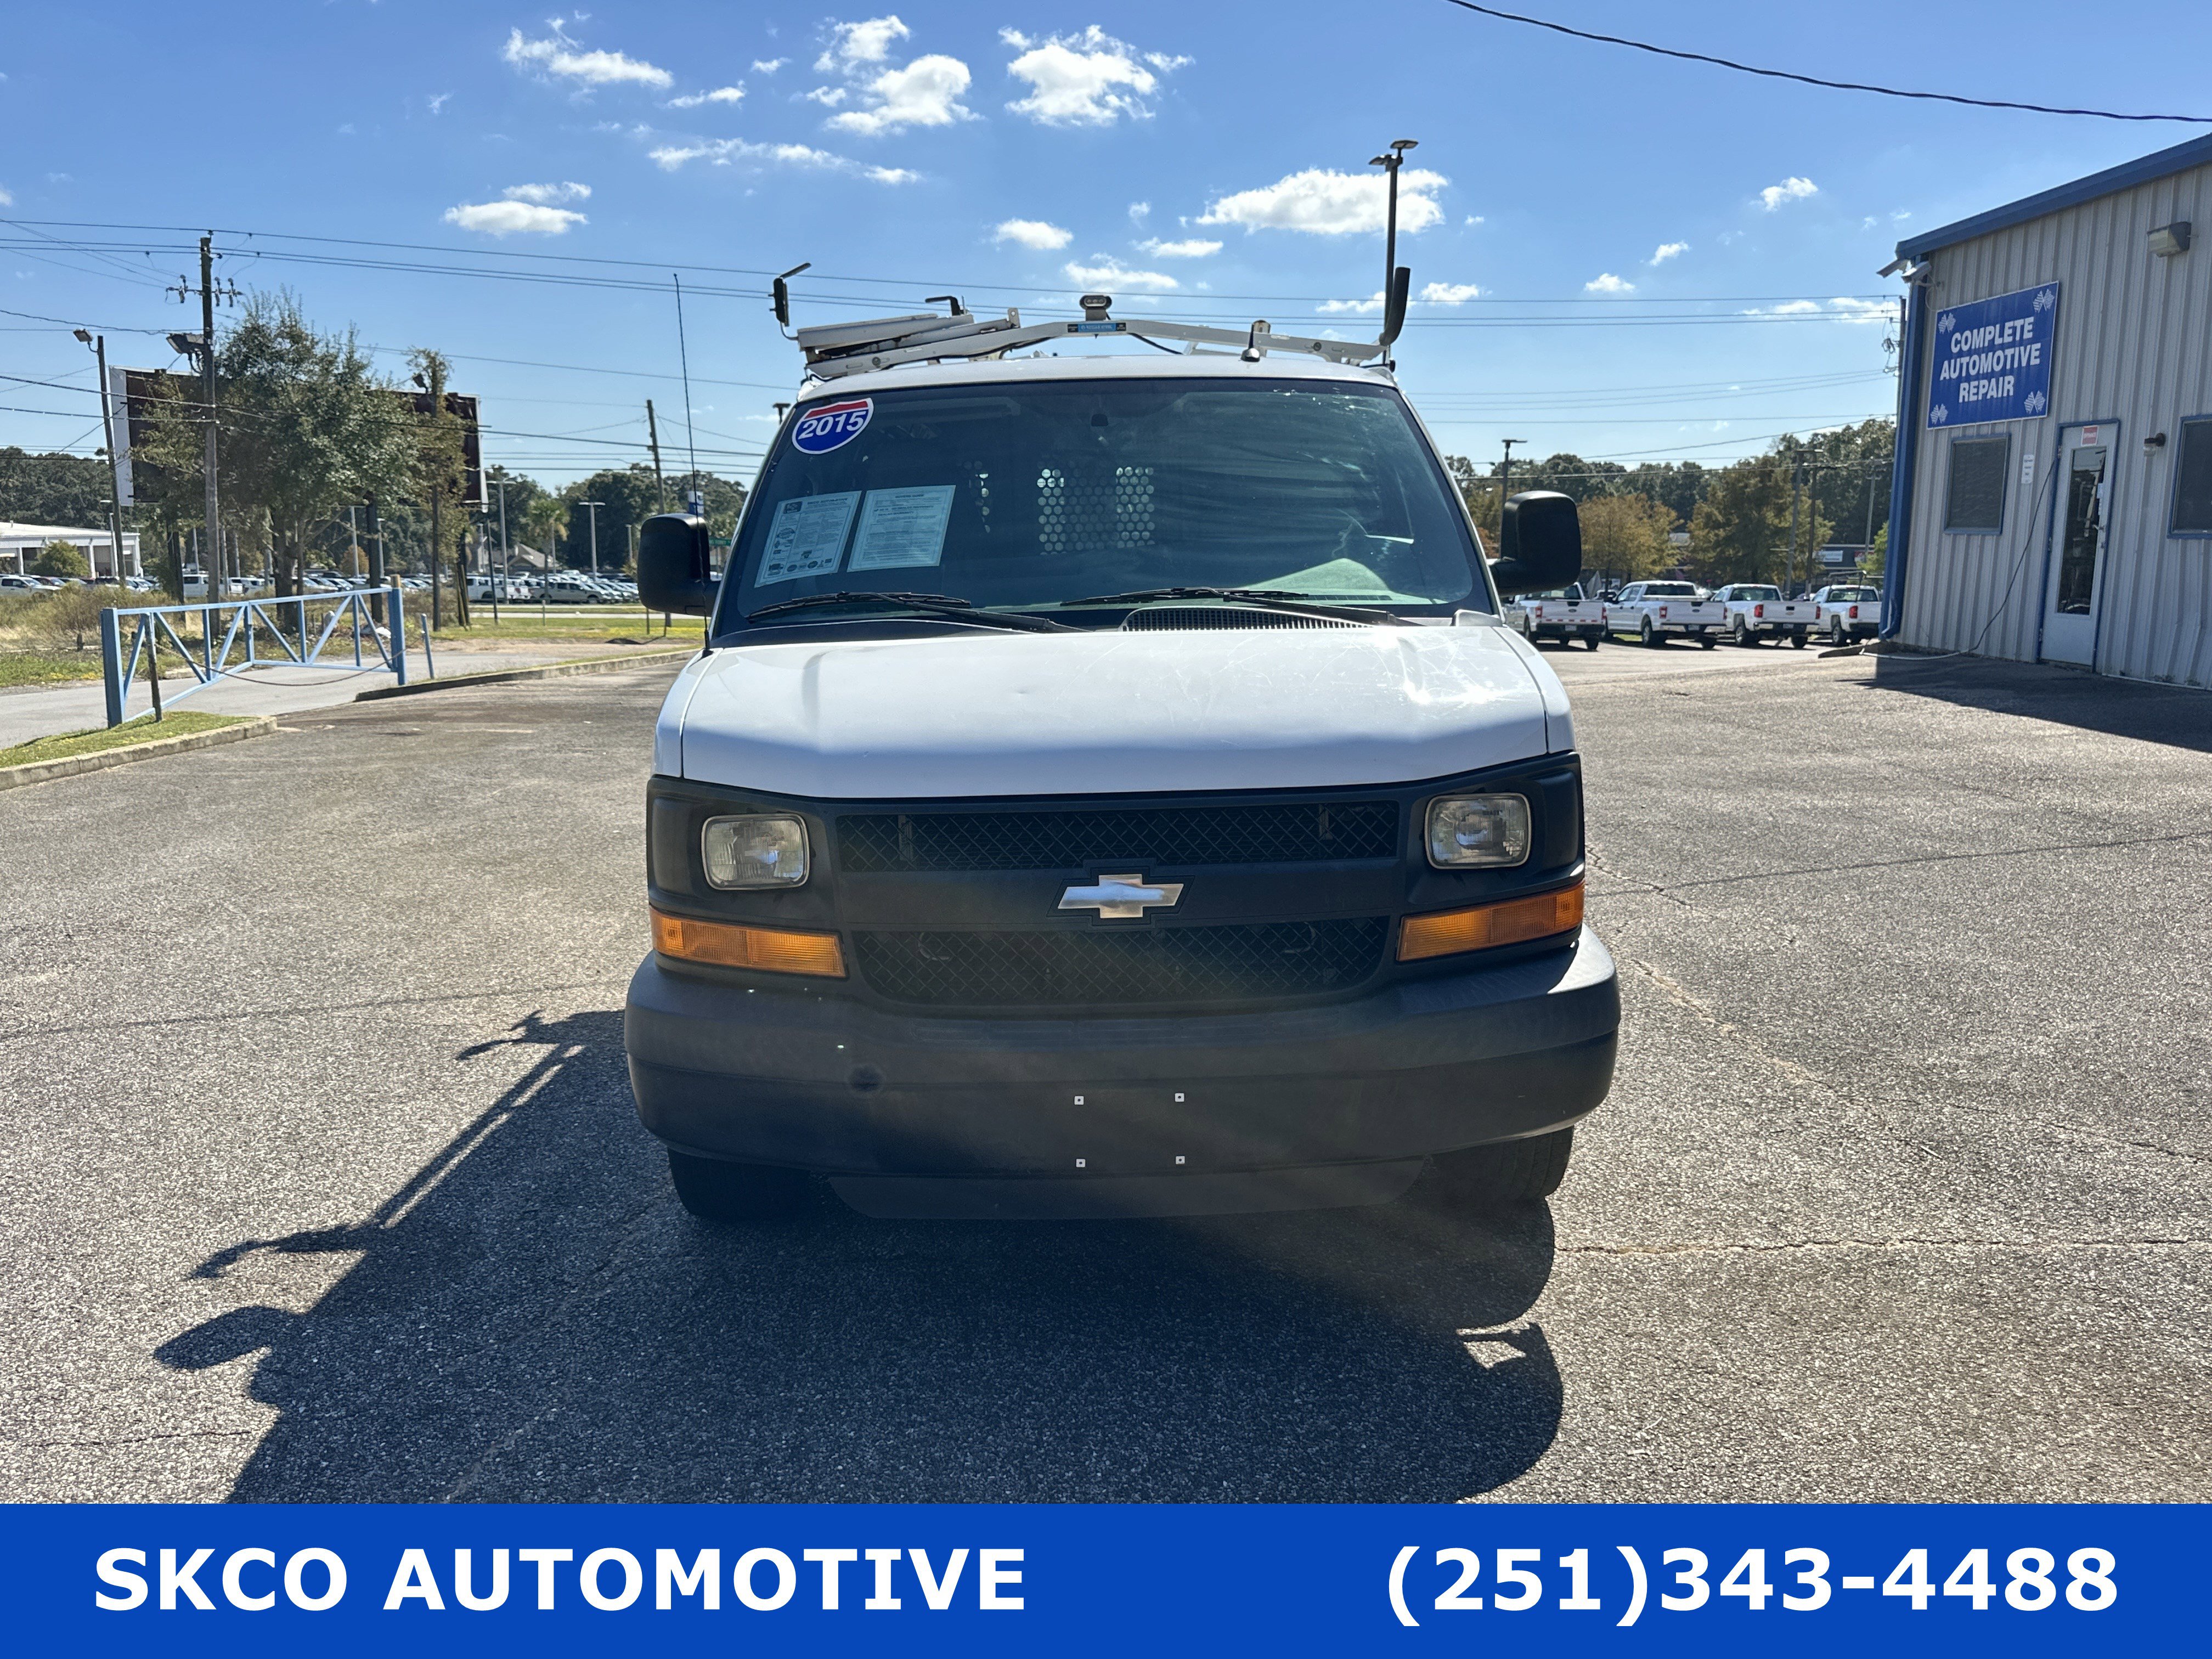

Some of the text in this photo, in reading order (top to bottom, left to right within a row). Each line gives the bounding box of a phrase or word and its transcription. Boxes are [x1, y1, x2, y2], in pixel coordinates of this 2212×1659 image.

[1950, 317, 2034, 353] COMPLETE
[1939, 342, 2041, 381] AUTOMOTIVE
[1959, 375, 2015, 403] REPAIR
[798, 410, 866, 440] 2015
